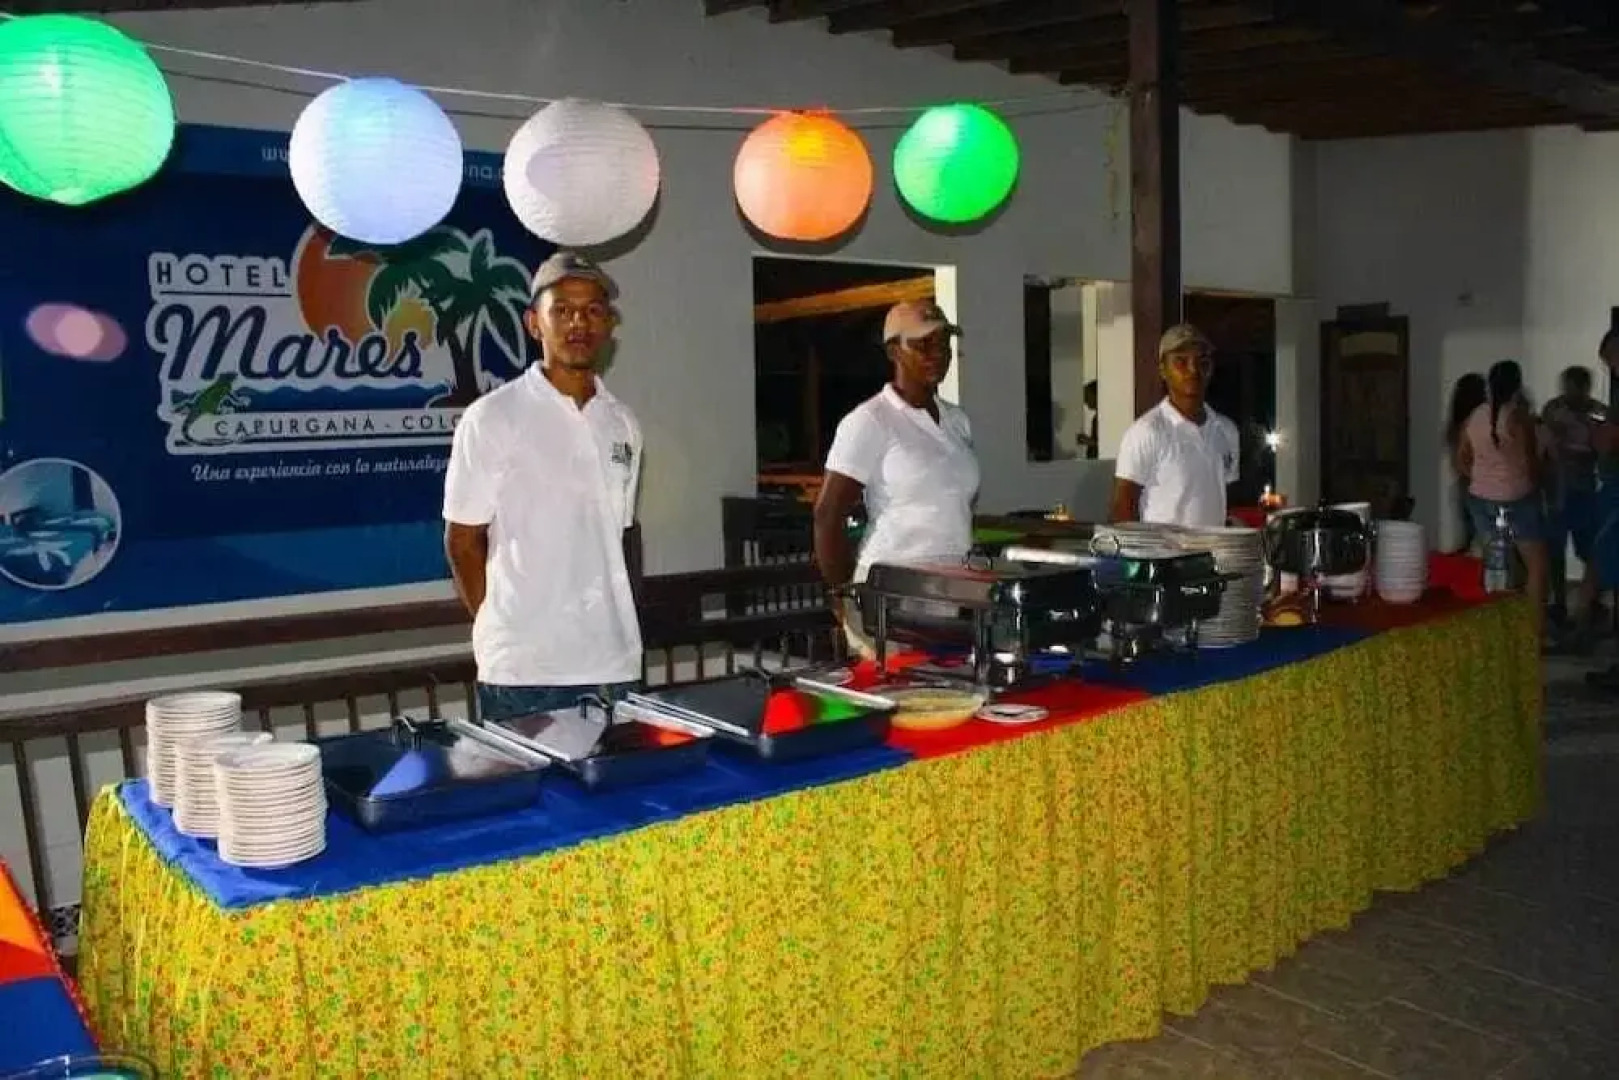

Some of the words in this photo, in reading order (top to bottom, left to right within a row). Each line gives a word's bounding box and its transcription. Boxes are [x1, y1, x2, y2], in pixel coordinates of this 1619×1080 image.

[156, 260, 286, 288] HOTEL
[154, 303, 423, 380] Mares
[191, 463, 231, 482] Una
[234, 460, 321, 484] experiencia
[325, 463, 351, 475] con
[355, 458, 370, 474] la
